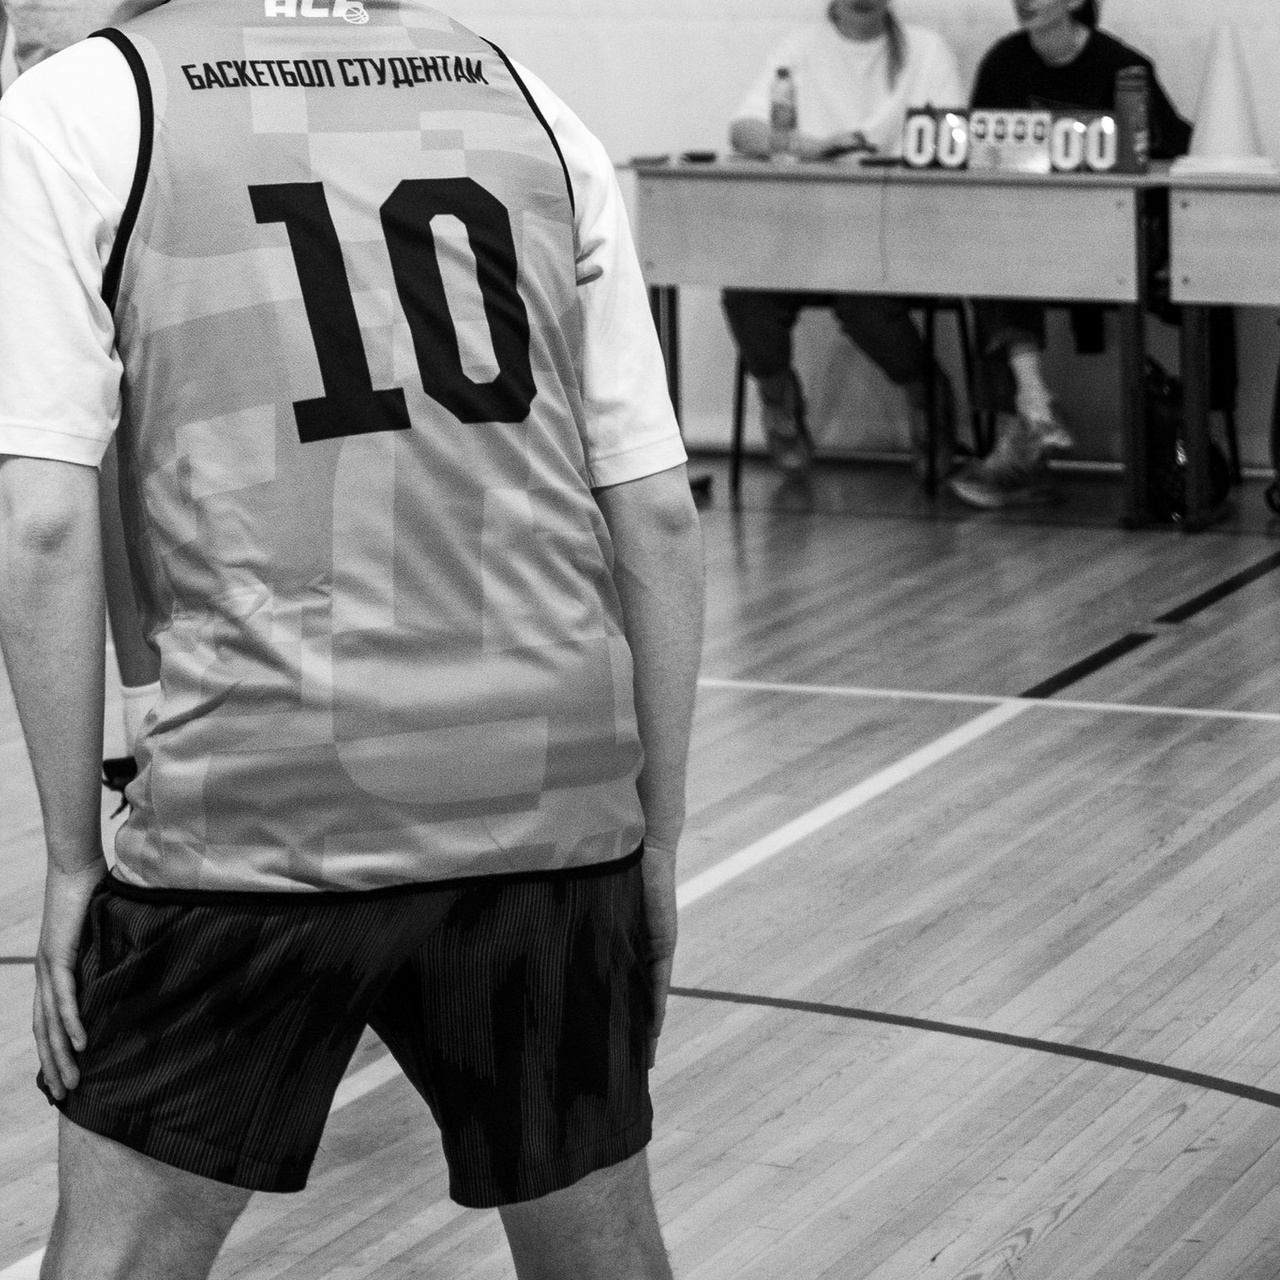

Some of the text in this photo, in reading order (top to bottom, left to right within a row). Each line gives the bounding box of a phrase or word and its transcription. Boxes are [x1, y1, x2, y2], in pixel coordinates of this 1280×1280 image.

[181, 56, 489, 90] БАСКЕТБОЛ СТУДЕНТАМ
[247, 177, 538, 444] 10
